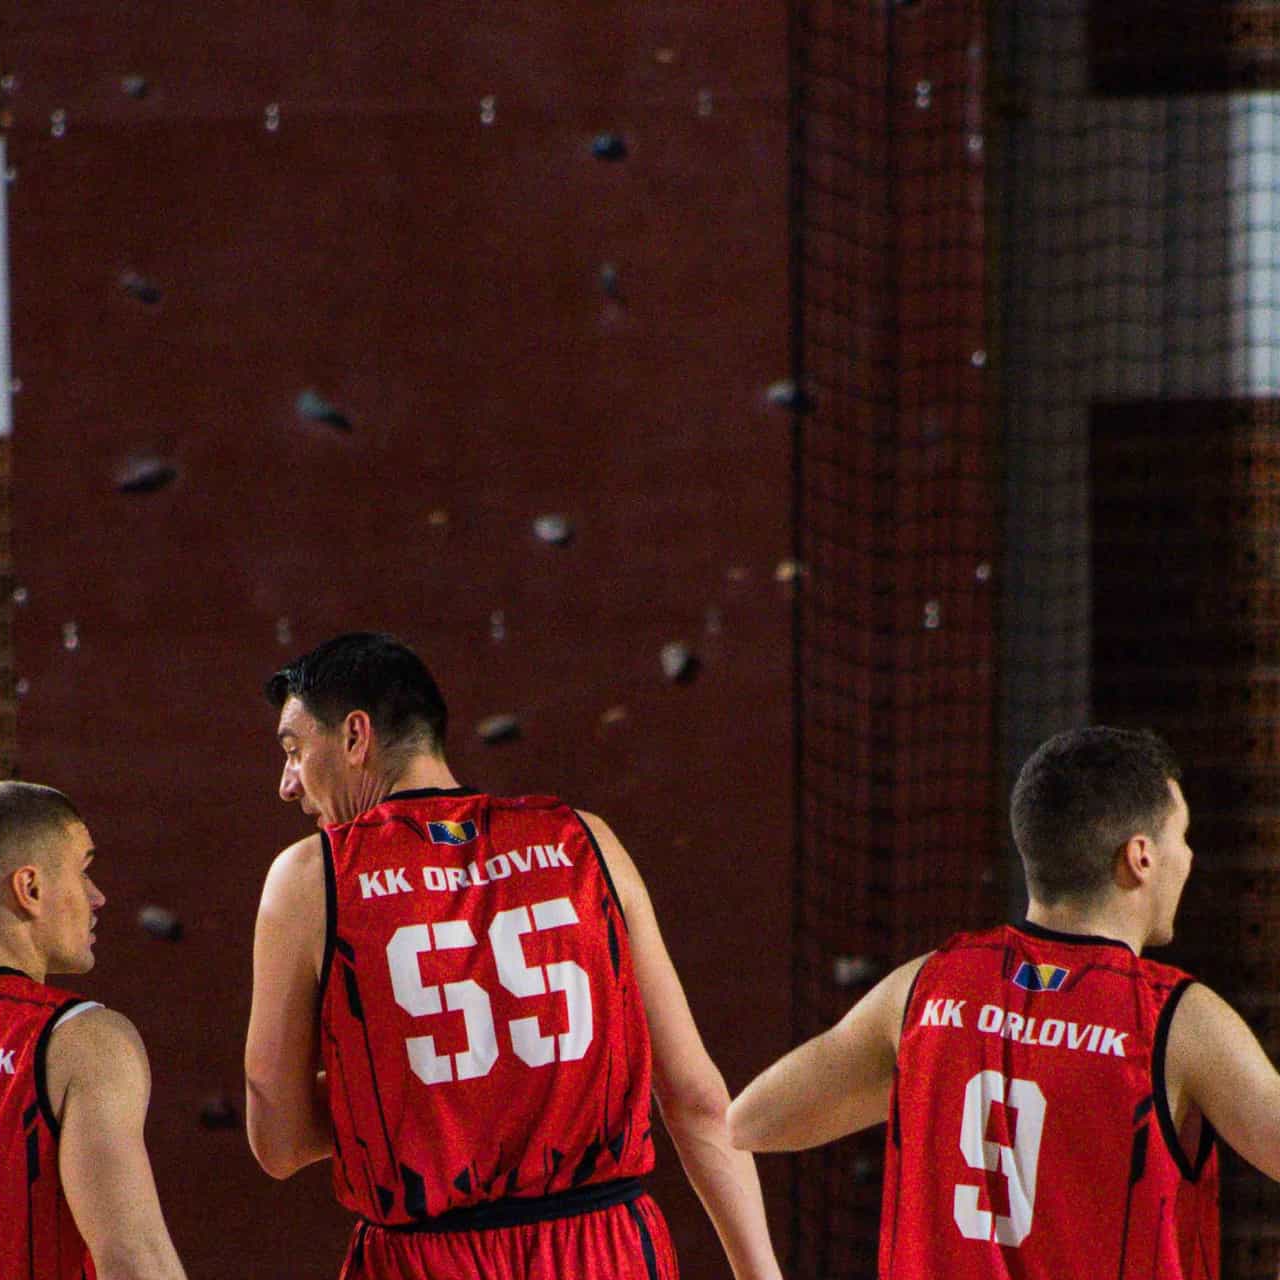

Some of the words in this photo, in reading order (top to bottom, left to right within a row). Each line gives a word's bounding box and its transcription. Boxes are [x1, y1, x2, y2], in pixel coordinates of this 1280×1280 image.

[358, 867, 413, 899] KK
[422, 842, 574, 892] ORLOVIK
[386, 897, 594, 1086] 55
[920, 999, 967, 1028] KK
[977, 1004, 1129, 1057] ORLOVIK
[953, 1070, 1047, 1248] 9
